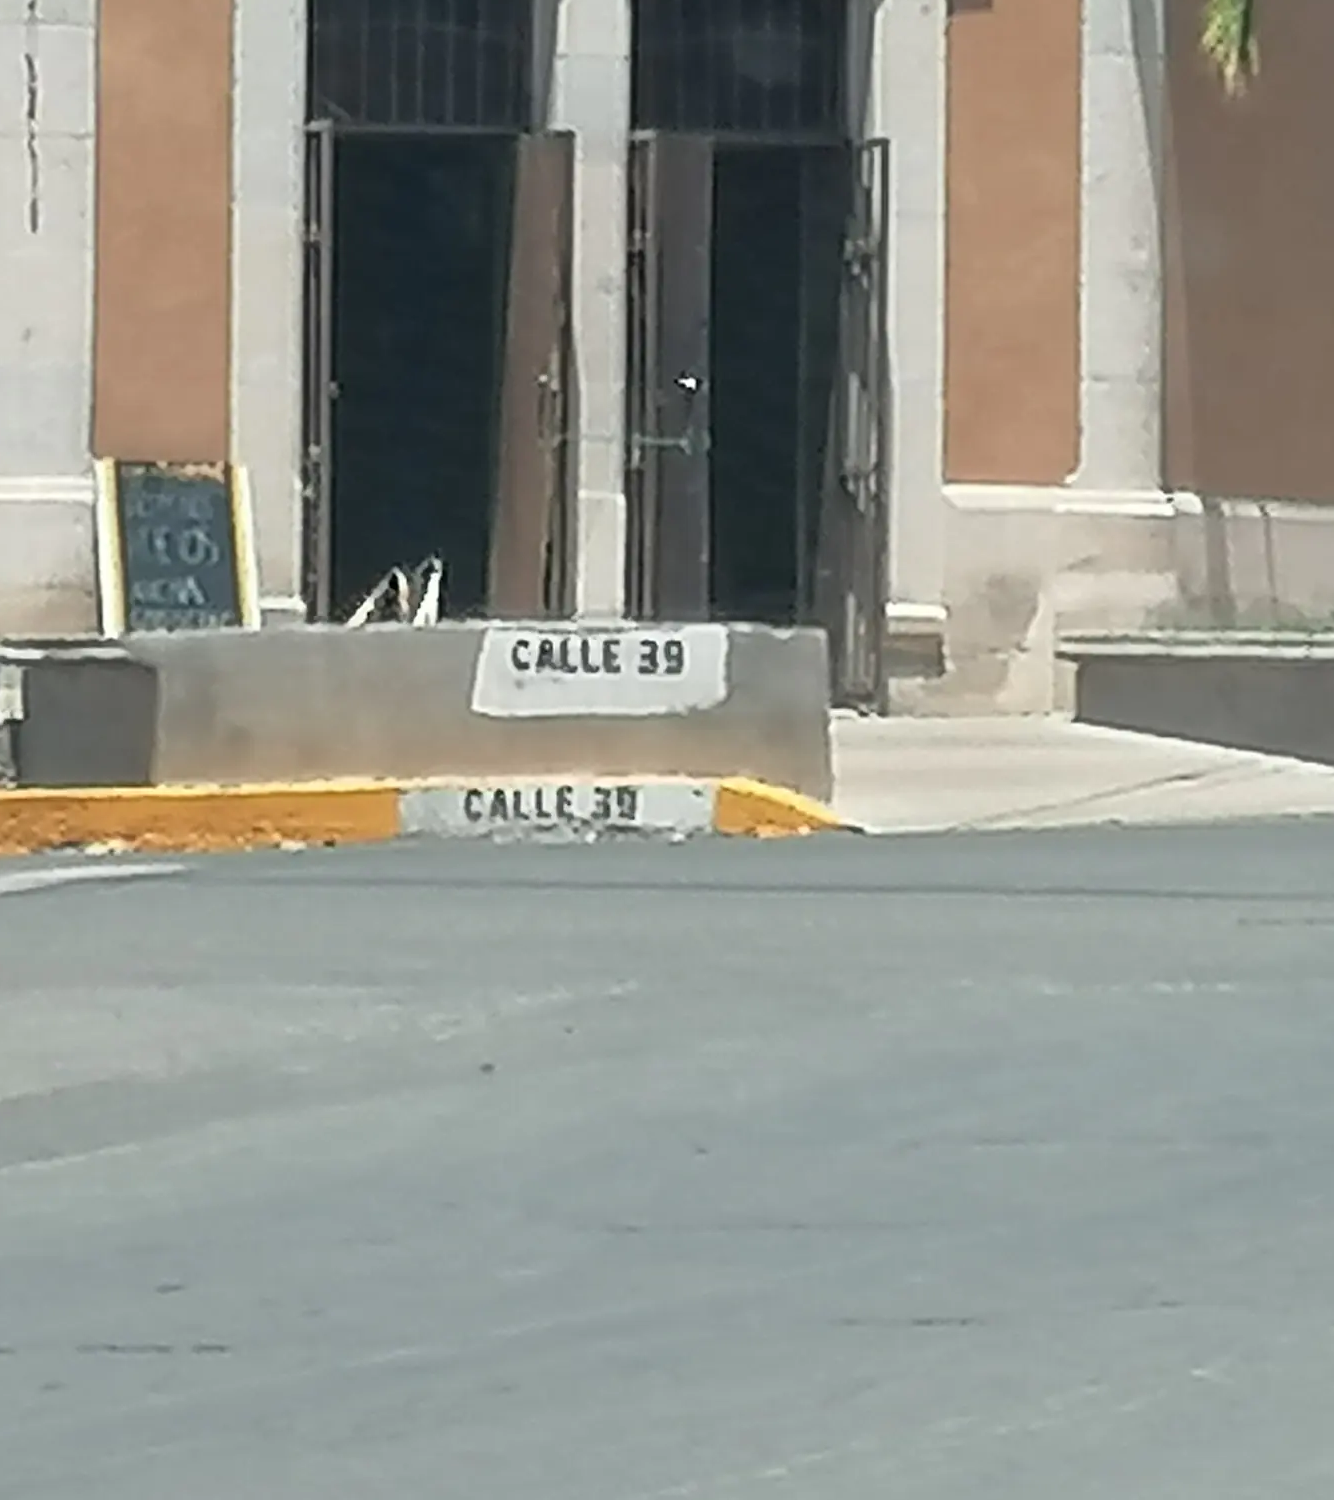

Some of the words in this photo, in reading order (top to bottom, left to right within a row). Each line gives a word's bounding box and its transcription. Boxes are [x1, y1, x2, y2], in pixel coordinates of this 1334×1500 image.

[511, 638, 622, 674] CALLE
[638, 638, 685, 675] 39
[463, 784, 574, 822] CALLE
[590, 785, 637, 821] 39
